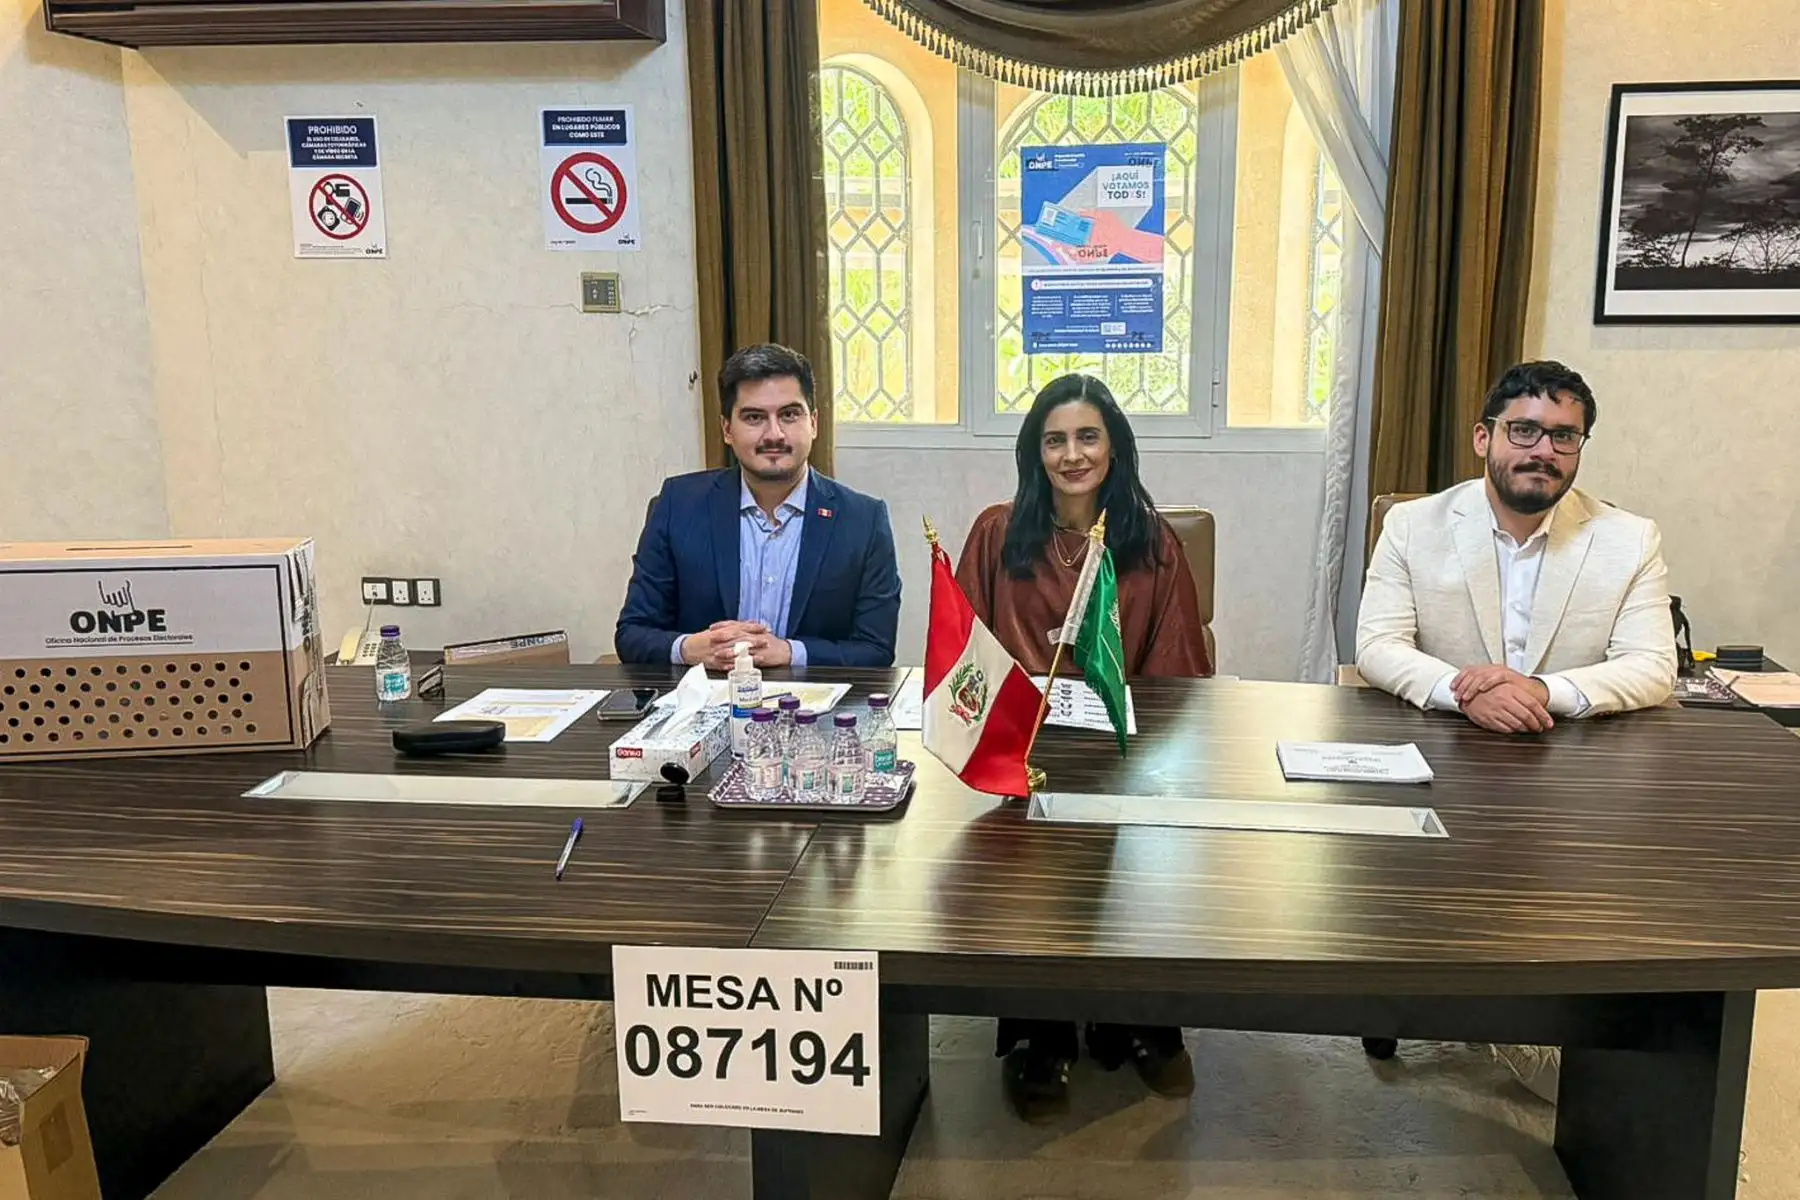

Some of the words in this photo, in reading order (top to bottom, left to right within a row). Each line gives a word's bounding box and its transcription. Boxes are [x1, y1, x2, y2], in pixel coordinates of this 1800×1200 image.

[308, 126, 357, 134] PROHIBIDO
[1028, 159, 1053, 169] ONPE
[1103, 181, 1150, 191] VOTAMOS
[70, 609, 167, 635] ONPE
[46, 636, 73, 644] Oficina
[74, 635, 107, 643] Nacional
[119, 634, 152, 642] Procesos
[153, 633, 193, 641] Electorales
[646, 974, 780, 1010] MESA
[794, 978, 843, 1013] Nº
[624, 1025, 872, 1087] 087194
